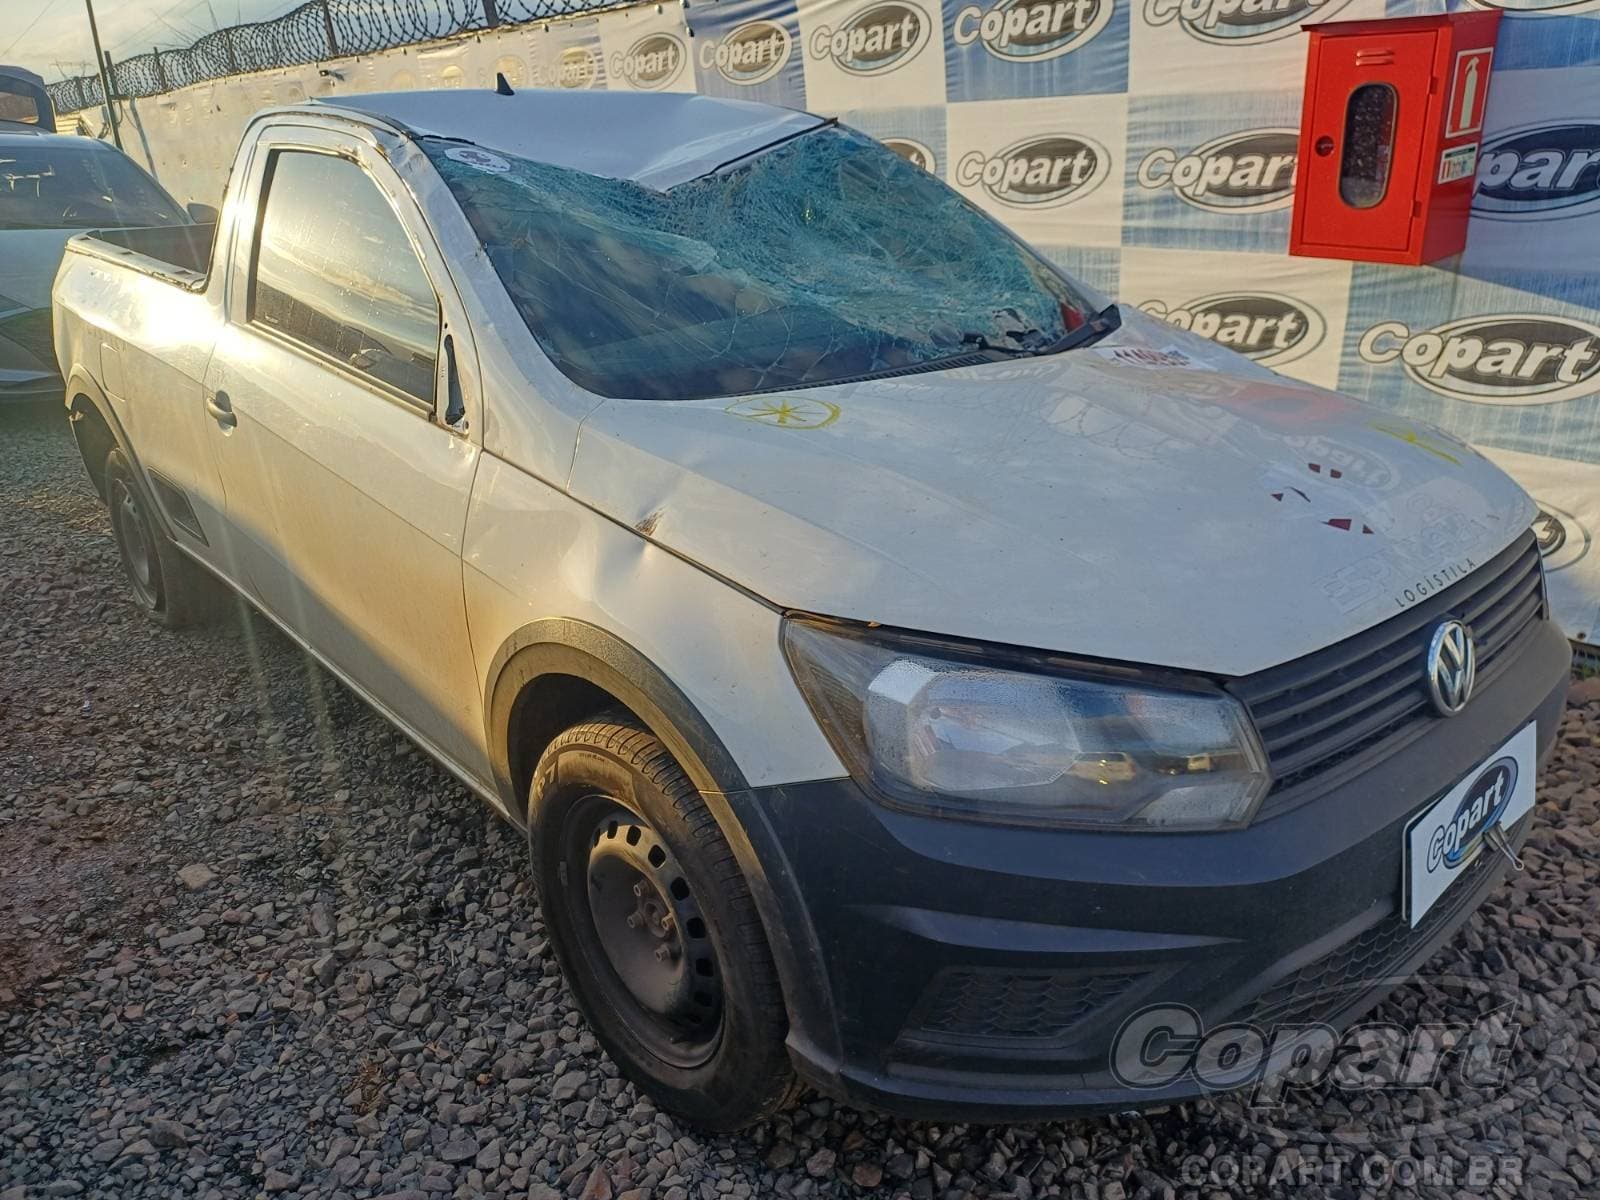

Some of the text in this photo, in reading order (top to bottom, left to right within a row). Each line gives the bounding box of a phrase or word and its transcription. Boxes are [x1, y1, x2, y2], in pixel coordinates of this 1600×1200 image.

[809, 14, 917, 62] Copart
[953, 0, 1093, 48] Copart
[609, 47, 677, 79] Copart
[700, 32, 785, 73] Copart
[956, 147, 1091, 193] Copart
[1137, 148, 1299, 196] Copar
[1359, 321, 1595, 384] Copart
[1427, 770, 1504, 873] Copart
